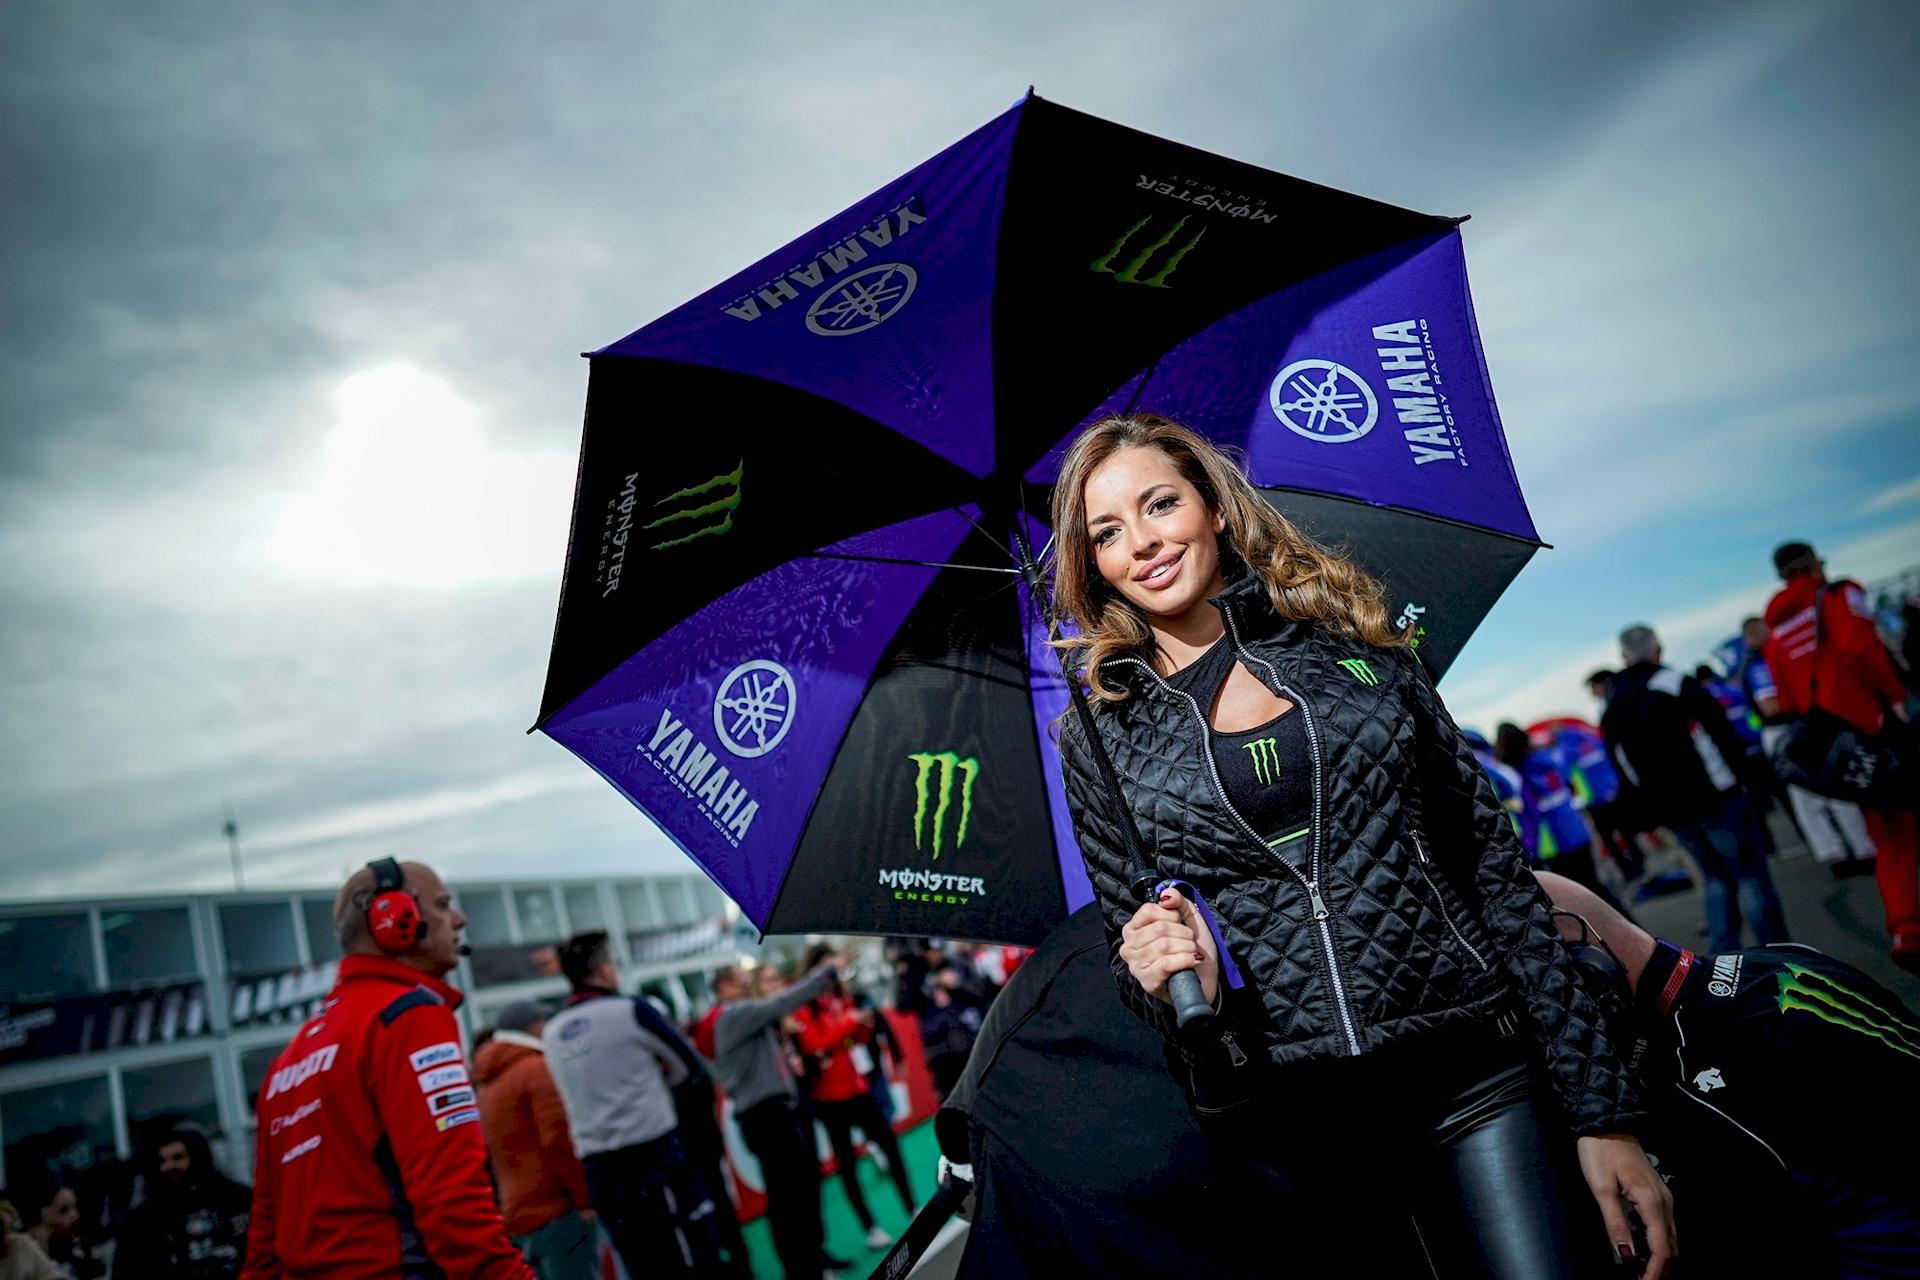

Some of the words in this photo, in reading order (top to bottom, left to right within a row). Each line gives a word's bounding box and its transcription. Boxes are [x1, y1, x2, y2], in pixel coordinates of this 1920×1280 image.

[1136, 174, 1278, 224] MONSTER
[724, 206, 928, 322] YAMAHA
[1372, 319, 1456, 466] YAMAHA
[1419, 318, 1442, 385] RACING
[1439, 393, 1469, 467] FACTORY
[602, 471, 639, 598] MONSTER
[636, 744, 695, 800] FACTORY
[697, 803, 740, 849] RACING
[647, 708, 760, 841] YAMAHA
[878, 867, 986, 896] MONSTER
[894, 890, 969, 906] ENERGY
